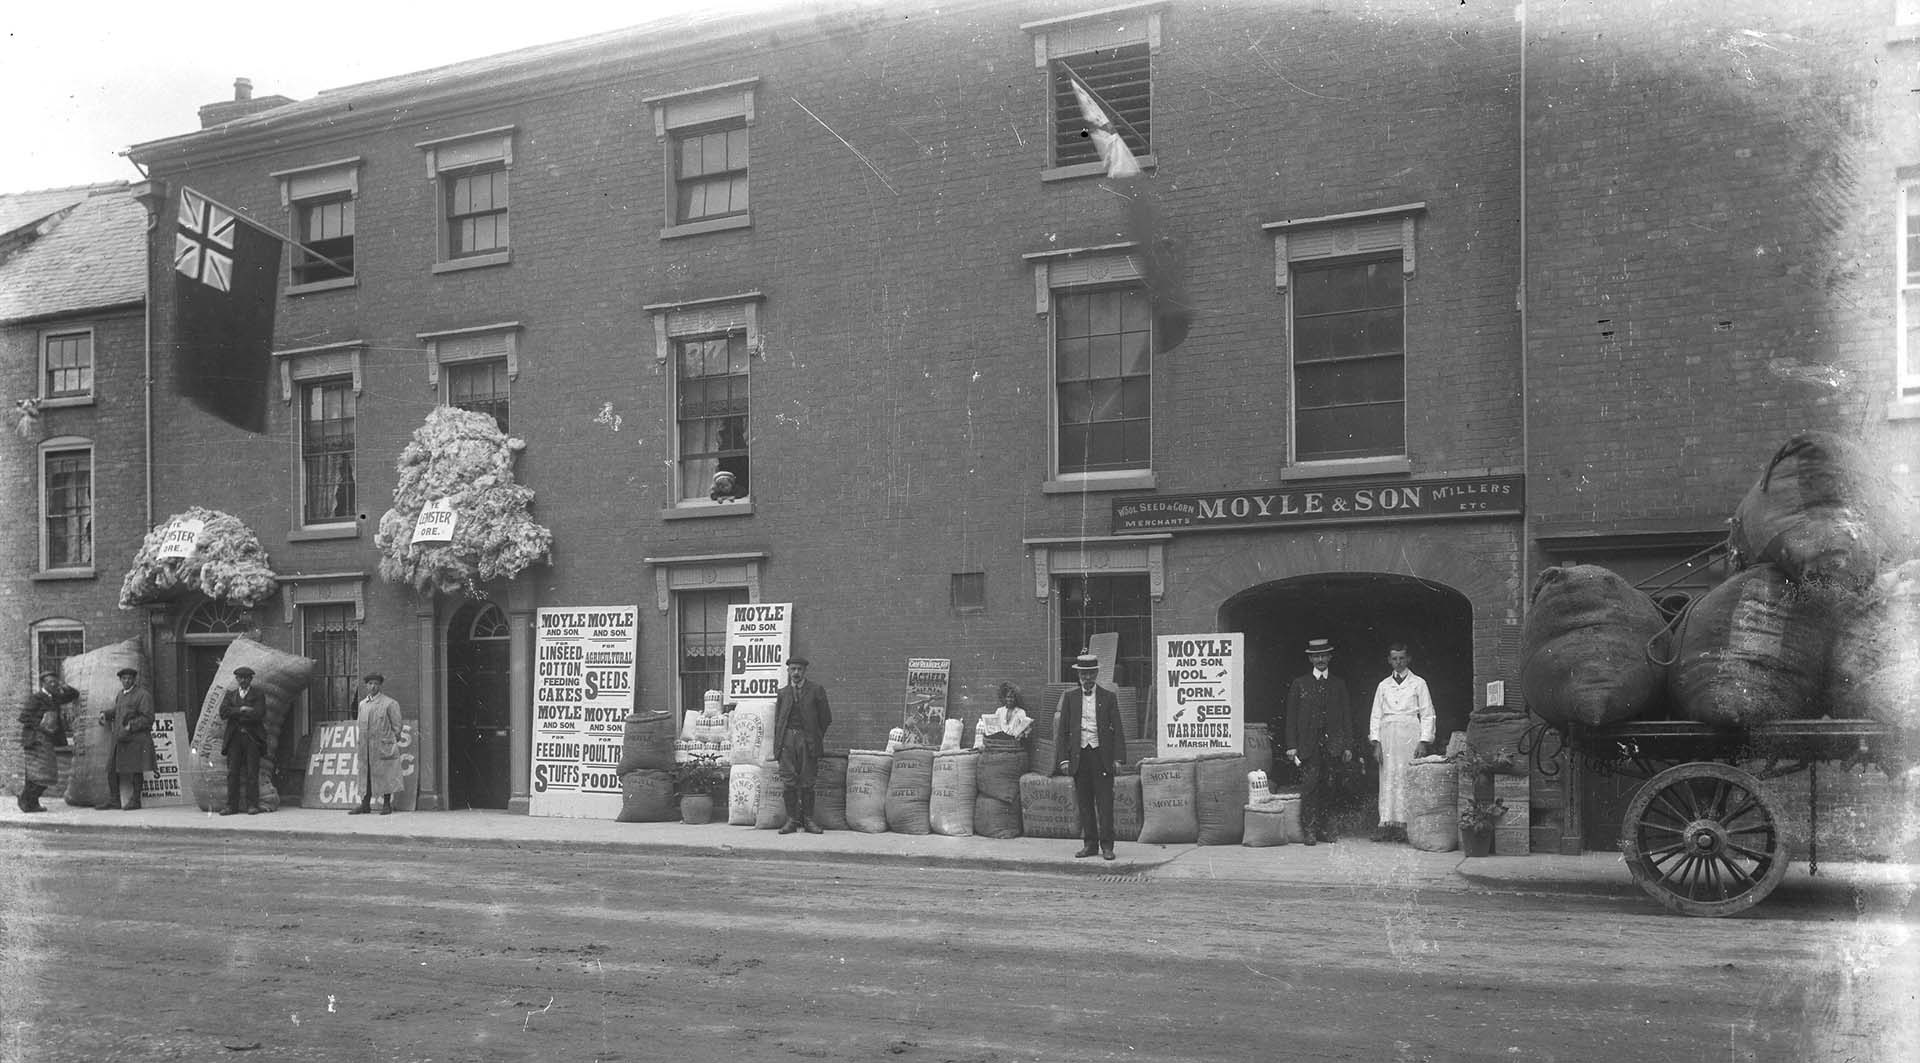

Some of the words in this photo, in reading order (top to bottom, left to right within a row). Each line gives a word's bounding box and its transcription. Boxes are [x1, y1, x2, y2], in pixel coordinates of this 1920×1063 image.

[1432, 483, 1511, 501] MILLERS
[1139, 502, 1166, 512] SEED
[1173, 501, 1195, 513] CORN
[1196, 492, 1324, 519] MOYLE
[1331, 496, 1351, 512] &
[1354, 486, 1424, 511] SON
[1459, 502, 1487, 510] ETC
[1125, 517, 1191, 527] MERCHANTS
[541, 613, 586, 628] MOYLE
[588, 613, 634, 628] MOYLE
[734, 606, 784, 622] MOYLE
[1167, 639, 1232, 658] MOYLE
[585, 652, 633, 665] AGRICULTURAL
[732, 644, 782, 675] BAKING
[1176, 658, 1197, 667] AND
[543, 677, 580, 686] FEEDING
[1167, 669, 1208, 688] WOOL
[730, 679, 779, 694] FLOUR
[539, 687, 583, 702] CAKES
[1176, 686, 1216, 705] CORN.
[538, 705, 582, 720] MOYLE
[584, 707, 630, 723] MOYLE
[1197, 705, 1232, 722] SEED
[543, 721, 558, 729] AND
[1167, 723, 1232, 739] WAREHOUSE.
[536, 742, 580, 758] FEEDING
[1178, 739, 1209, 748] MARSH
[582, 744, 624, 763] POULTR
[535, 764, 580, 793] STUFFS
[1150, 771, 1181, 782] MOYLE
[1151, 799, 1184, 808] MOYLE
